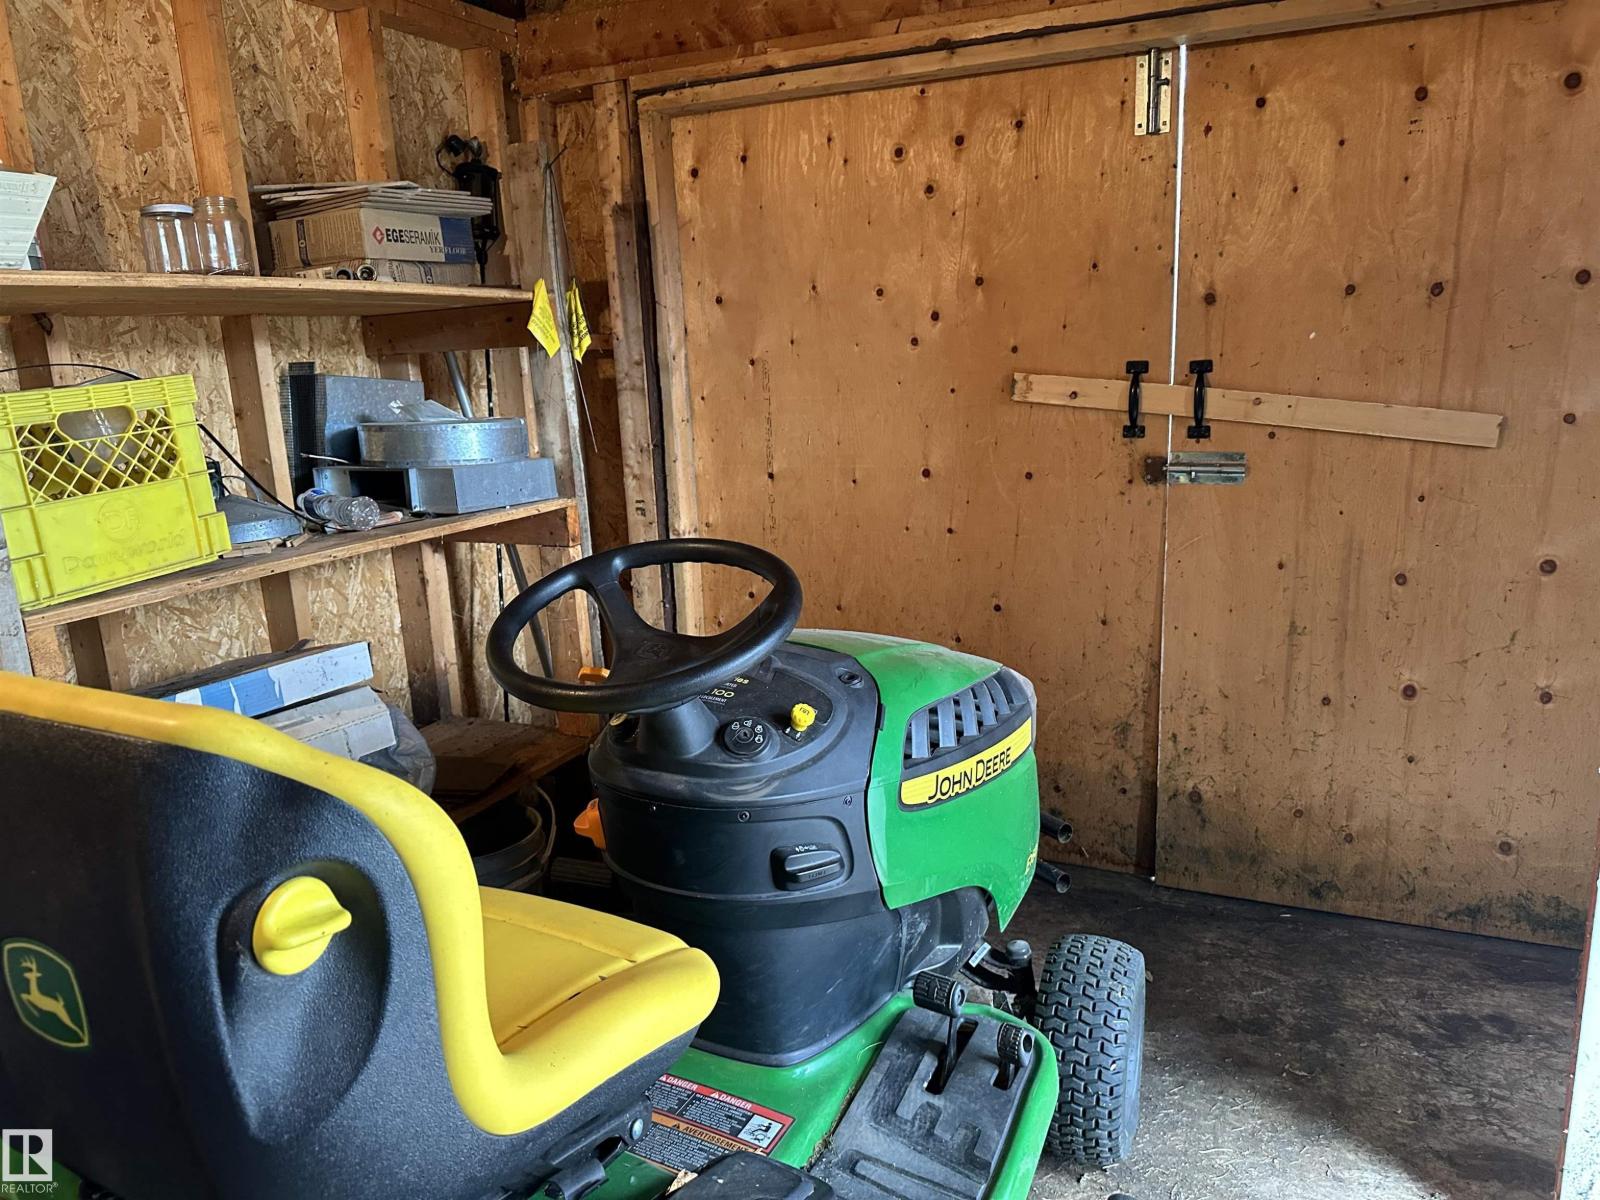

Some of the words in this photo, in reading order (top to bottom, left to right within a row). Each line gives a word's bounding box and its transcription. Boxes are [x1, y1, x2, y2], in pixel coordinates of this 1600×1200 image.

[710, 687, 736, 699] 100
[927, 767, 973, 801] JOHN
[975, 746, 1012, 783] DEERE
[666, 1075, 698, 1091] DANGER
[719, 1093, 753, 1110] DANGER
